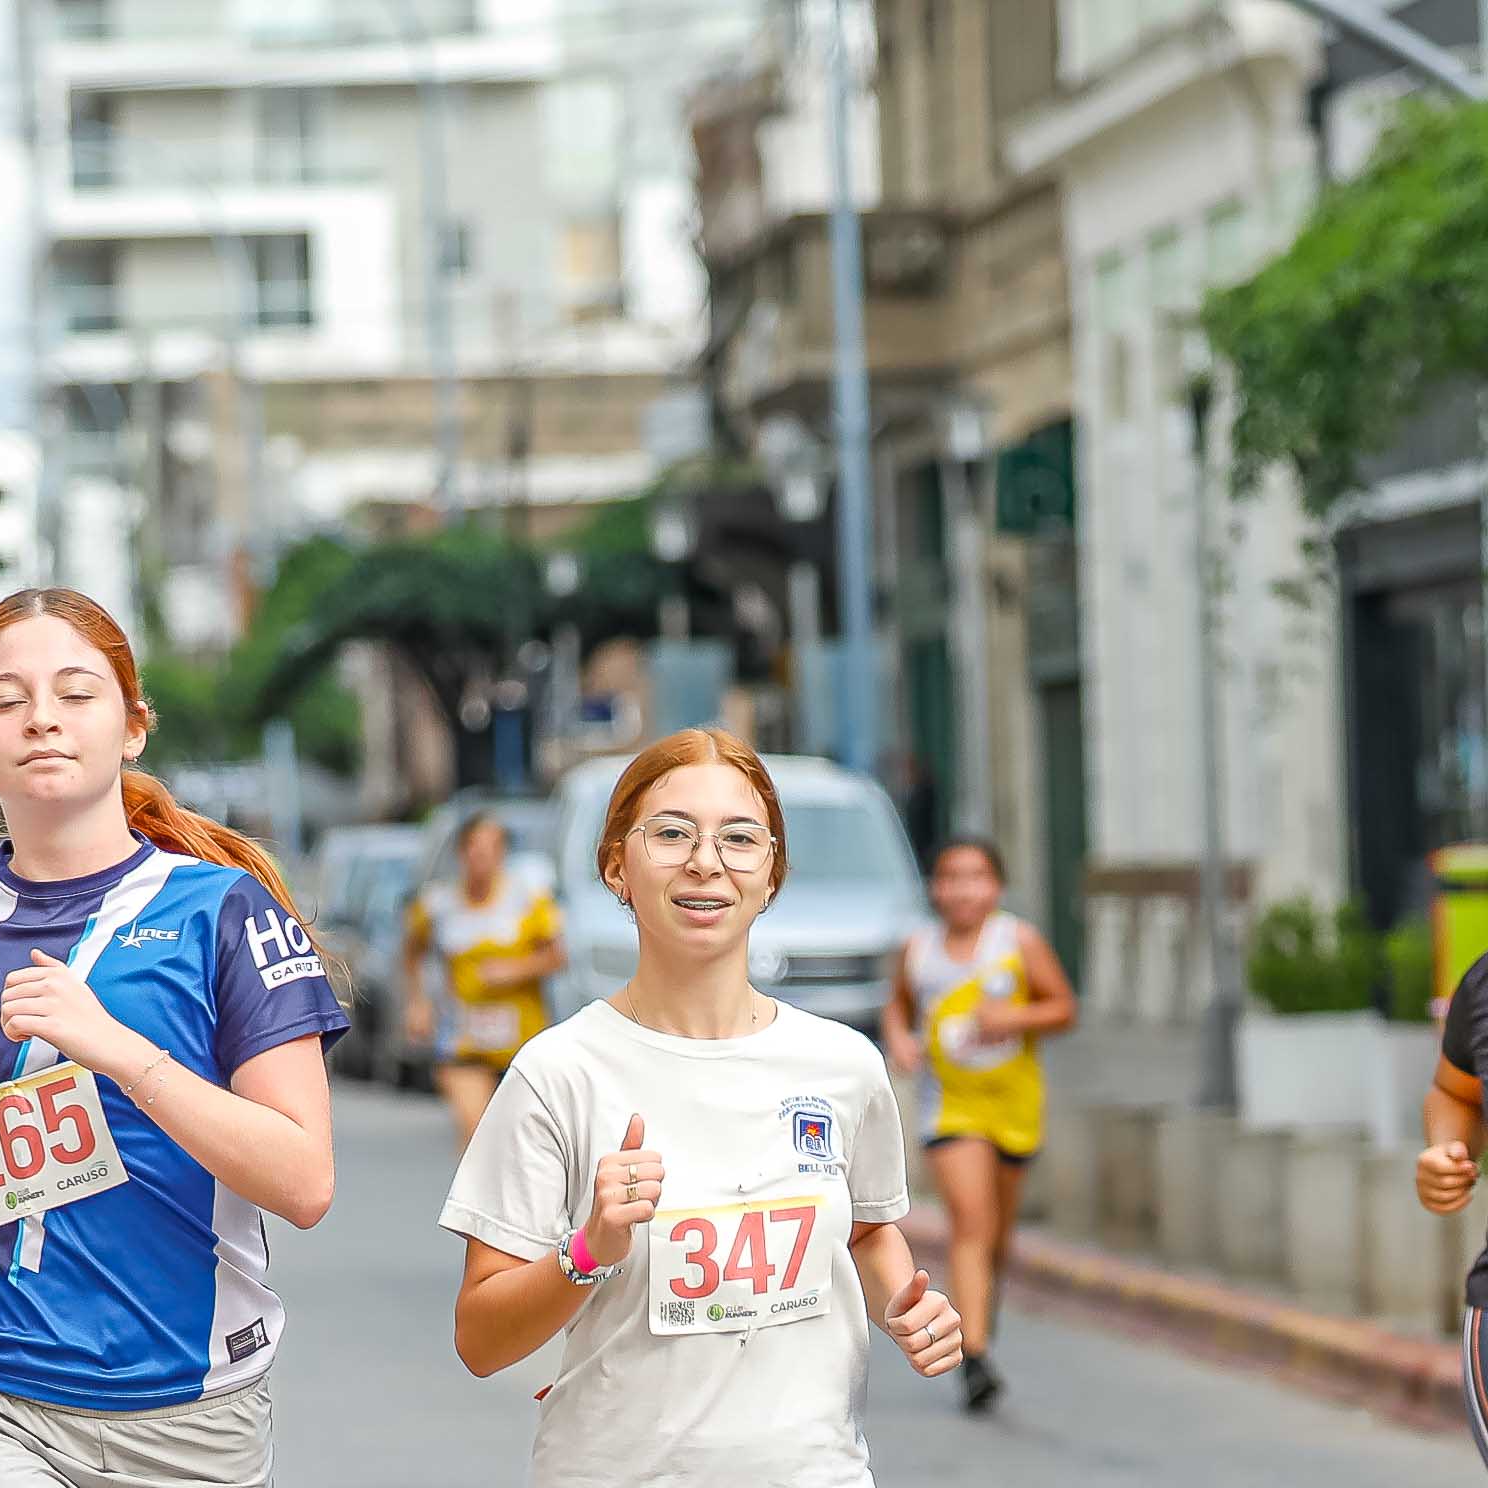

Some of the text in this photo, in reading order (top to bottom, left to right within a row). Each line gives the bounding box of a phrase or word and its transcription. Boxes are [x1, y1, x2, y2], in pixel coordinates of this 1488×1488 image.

[56, 1166, 109, 1191] CARUSO
[669, 1205, 817, 1299] 347
[770, 1296, 818, 1314] CARUSO
